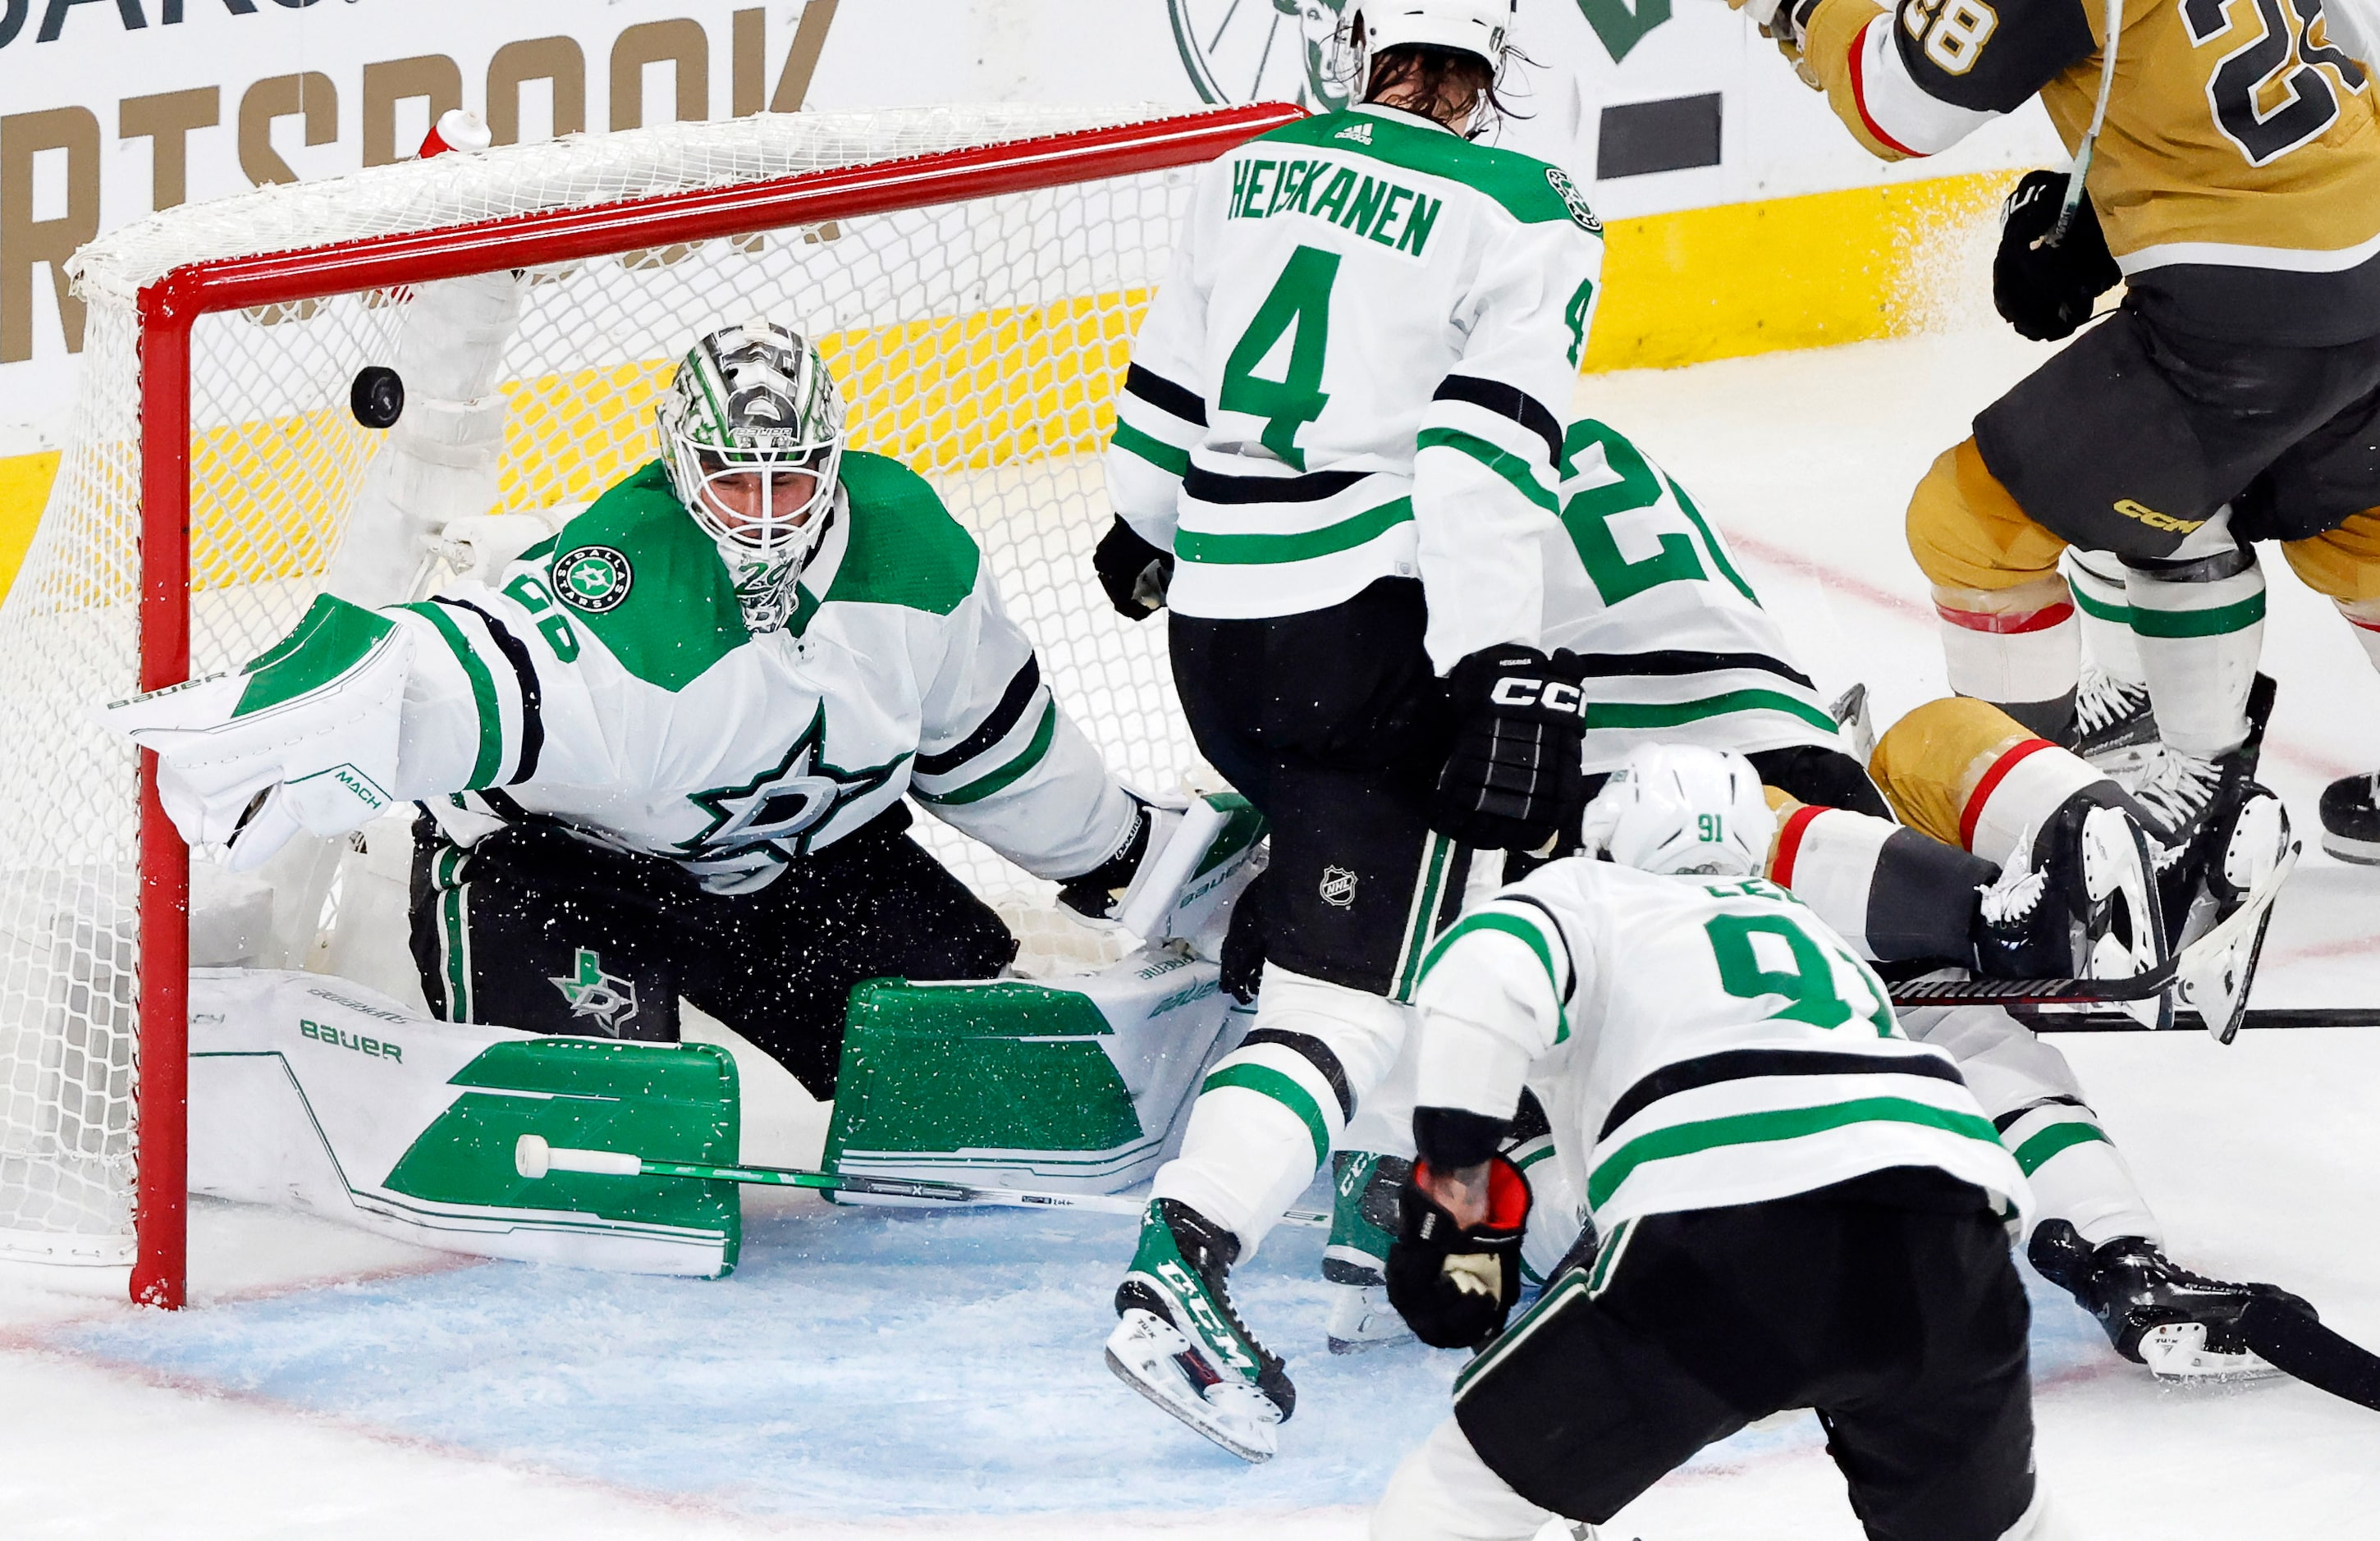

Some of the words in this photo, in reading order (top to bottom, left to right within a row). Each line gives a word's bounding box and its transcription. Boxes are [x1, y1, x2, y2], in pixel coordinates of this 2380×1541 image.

[1334, 130, 1373, 146] adidas
[1228, 159, 1442, 257] HEISKANEN
[1565, 277, 1593, 368] 4
[1219, 245, 1343, 473] 4
[2113, 498, 2205, 533] CCM
[557, 569, 602, 608] STARS
[574, 548, 625, 594] DALLAS
[335, 770, 382, 810] MACH
[1698, 813, 1723, 843] 91
[1326, 879, 1350, 894] NHL
[300, 1018, 403, 1064] BAUER
